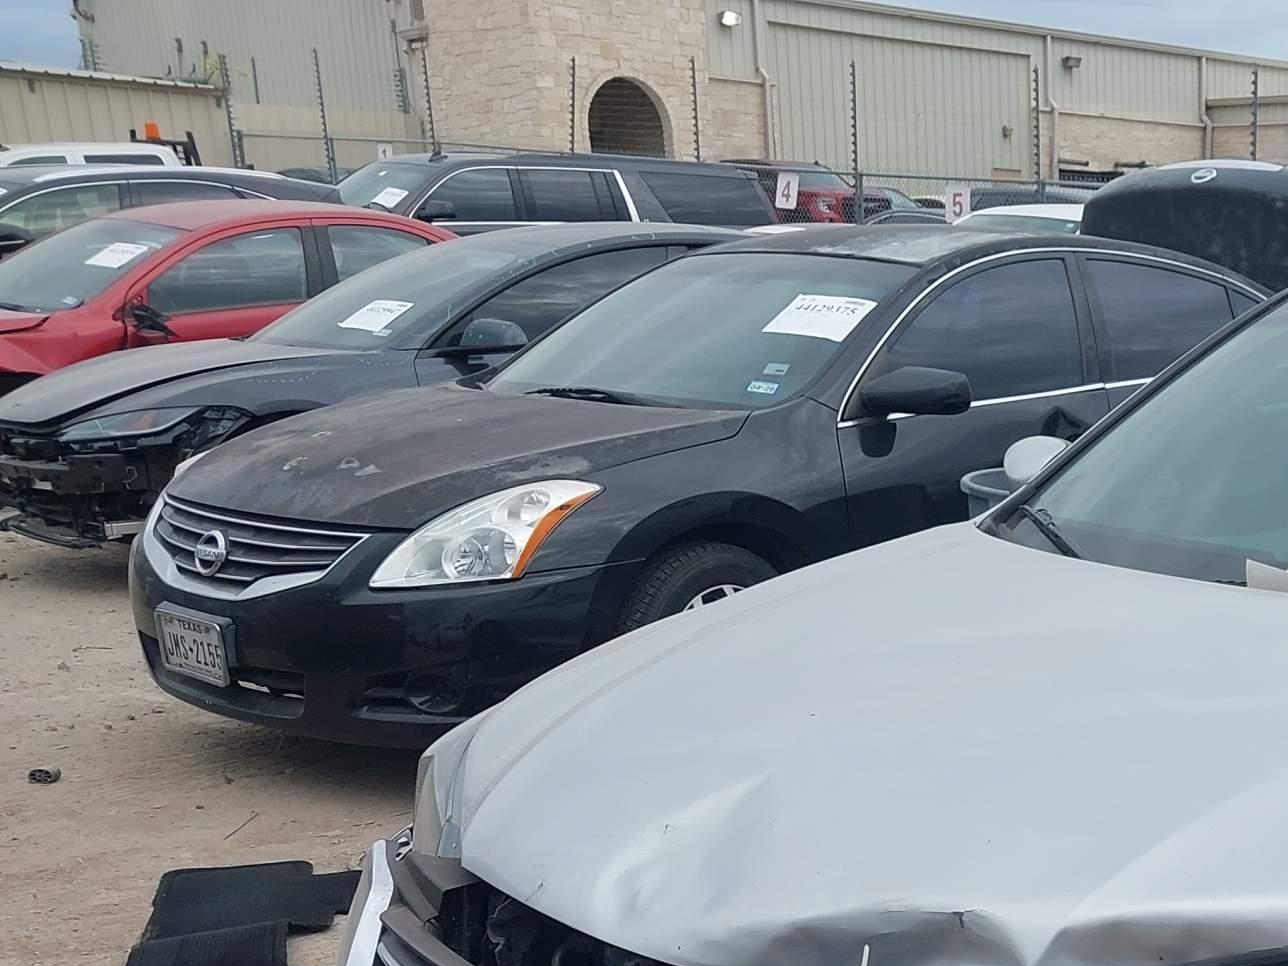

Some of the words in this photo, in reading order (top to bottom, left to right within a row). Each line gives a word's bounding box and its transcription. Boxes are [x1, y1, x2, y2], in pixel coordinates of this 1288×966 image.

[781, 180, 791, 203] 4
[952, 193, 963, 217] 5
[179, 620, 202, 633] TEXAS
